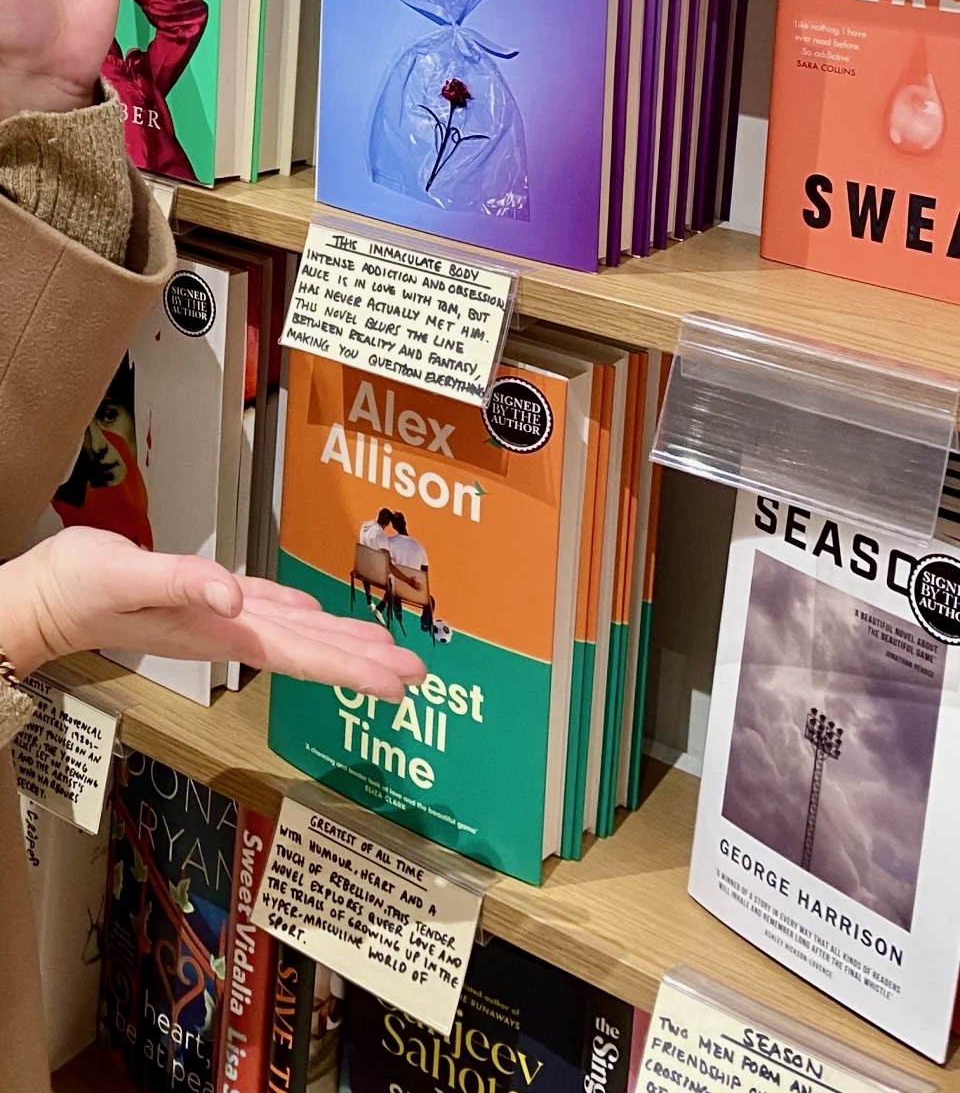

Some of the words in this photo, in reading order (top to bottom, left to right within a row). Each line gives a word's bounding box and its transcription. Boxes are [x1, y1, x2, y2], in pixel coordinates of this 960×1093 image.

[796, 59, 819, 71] SARA
[820, 64, 856, 76] COLLINS
[803, 174, 960, 261] SWE
[307, 248, 356, 271] INTENSE
[361, 262, 418, 285] ADDICTION
[422, 277, 445, 291] AND
[369, 243, 442, 272] IMMACULATE
[449, 264, 479, 281] BODY
[171, 285, 207, 302] SIGNED
[171, 294, 182, 306] BY
[185, 298, 208, 313] THE
[171, 305, 208, 321] AUTHOR
[298, 281, 320, 296] HAS
[324, 288, 362, 307] NEVER
[366, 297, 420, 320] ACTUALLY
[425, 315, 456, 332] MET
[461, 326, 490, 344] HIM.
[301, 264, 330, 282] ALICE
[354, 278, 366, 289] IN
[371, 282, 396, 296] LOVE
[402, 289, 432, 306] WITH
[437, 299, 461, 320] TOM,
[468, 308, 491, 323] BUT
[347, 380, 456, 459] Alex
[491, 414, 541, 436] AUTHOR
[492, 392, 541, 414] SIGNED
[492, 402, 509, 417] BY
[510, 407, 541, 426] THE
[320, 422, 481, 523] Allison
[754, 495, 915, 599] SEASO
[338, 708, 435, 790] Time
[392, 696, 447, 753] All
[65, 765, 98, 788] PENNING
[364, 785, 383, 800] ELIZA
[384, 795, 407, 811] CLARK
[138, 799, 233, 891] RYAN
[279, 824, 302, 846] WITH
[309, 839, 358, 876] HUMOUR,
[360, 869, 396, 894] HEART
[400, 890, 423, 909] AND
[428, 904, 437, 917] A
[310, 815, 357, 846] GREATEST
[360, 841, 374, 854] OF
[375, 849, 391, 865] ALL
[396, 859, 424, 882] TIME
[237, 829, 263, 919] Sweet
[720, 838, 790, 897] GEORGE
[797, 889, 903, 967] HARRISON
[230, 922, 256, 1016] Vidalia
[144, 988, 211, 1070] heart,
[273, 966, 298, 1050] SAVE
[471, 1000, 521, 1030] RUNAWAYS
[595, 1016, 621, 1039] the
[224, 1025, 248, 1082] Lisa
[698, 1034, 735, 1065] MEN
[741, 1055, 781, 1087] FORM
[743, 1027, 824, 1080] SEASON
